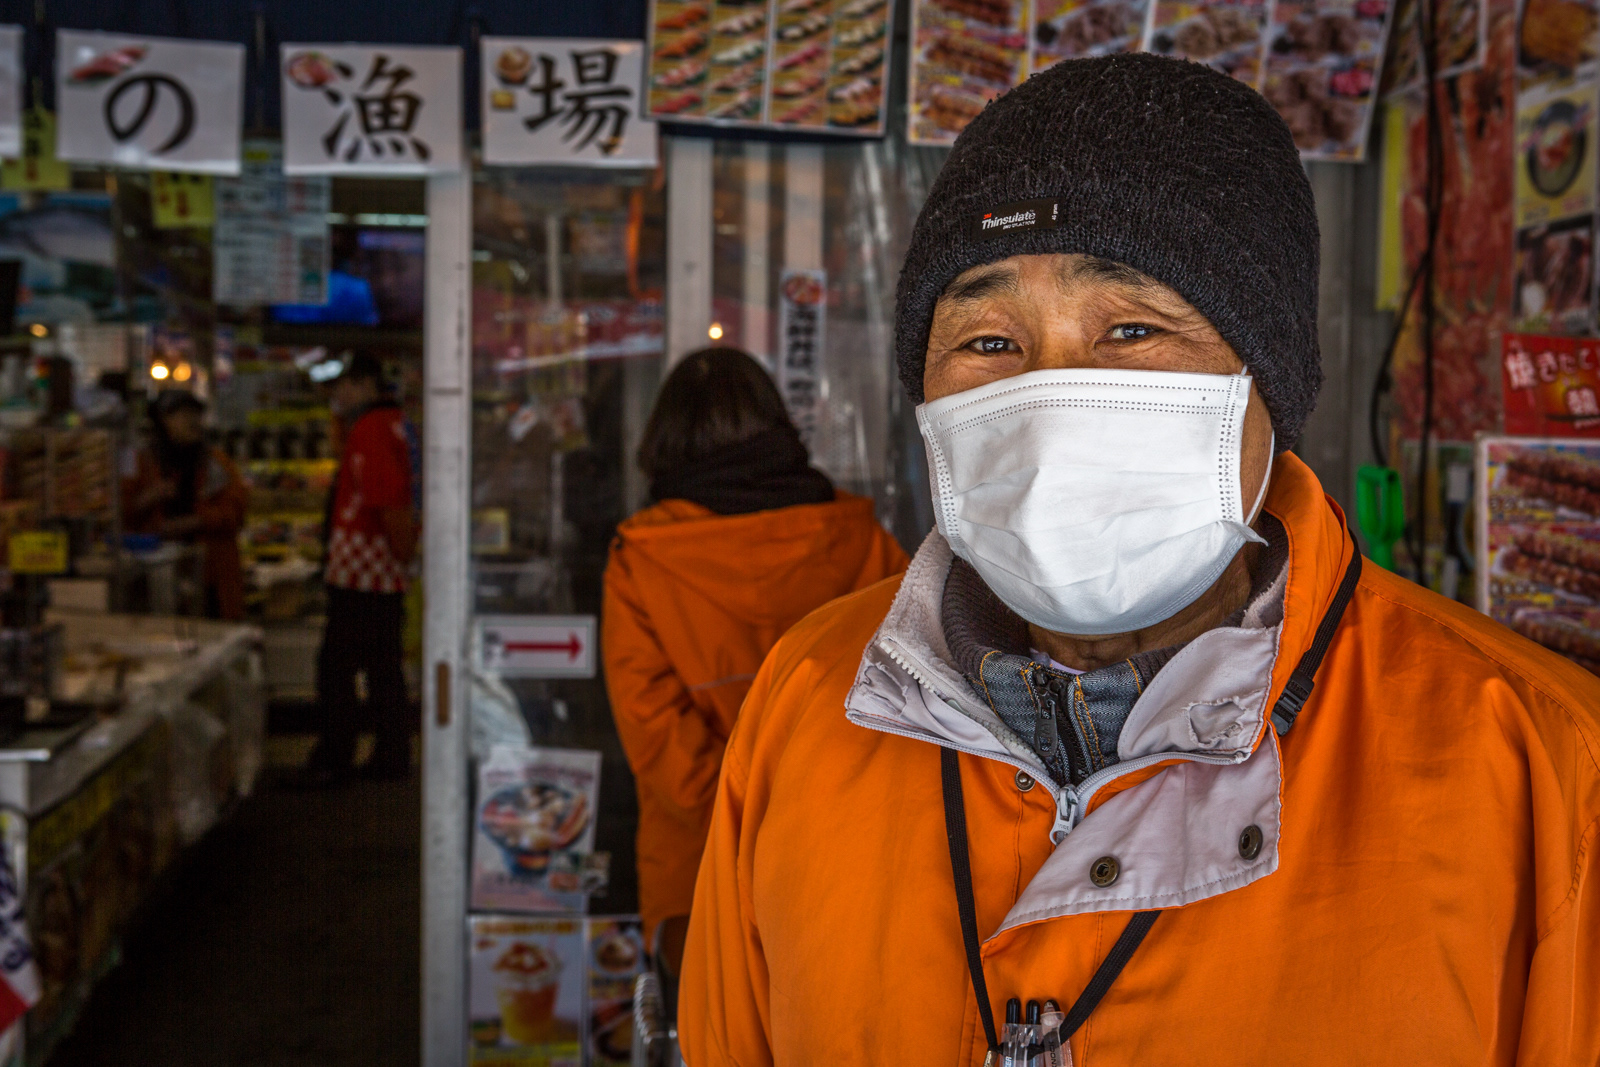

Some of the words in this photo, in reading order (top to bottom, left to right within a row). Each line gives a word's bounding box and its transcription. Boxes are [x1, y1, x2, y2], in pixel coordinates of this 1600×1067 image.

[104, 73, 194, 154] の
[322, 54, 430, 162] 漁
[523, 49, 631, 154] 場
[982, 211, 1036, 230] Thinsulate
